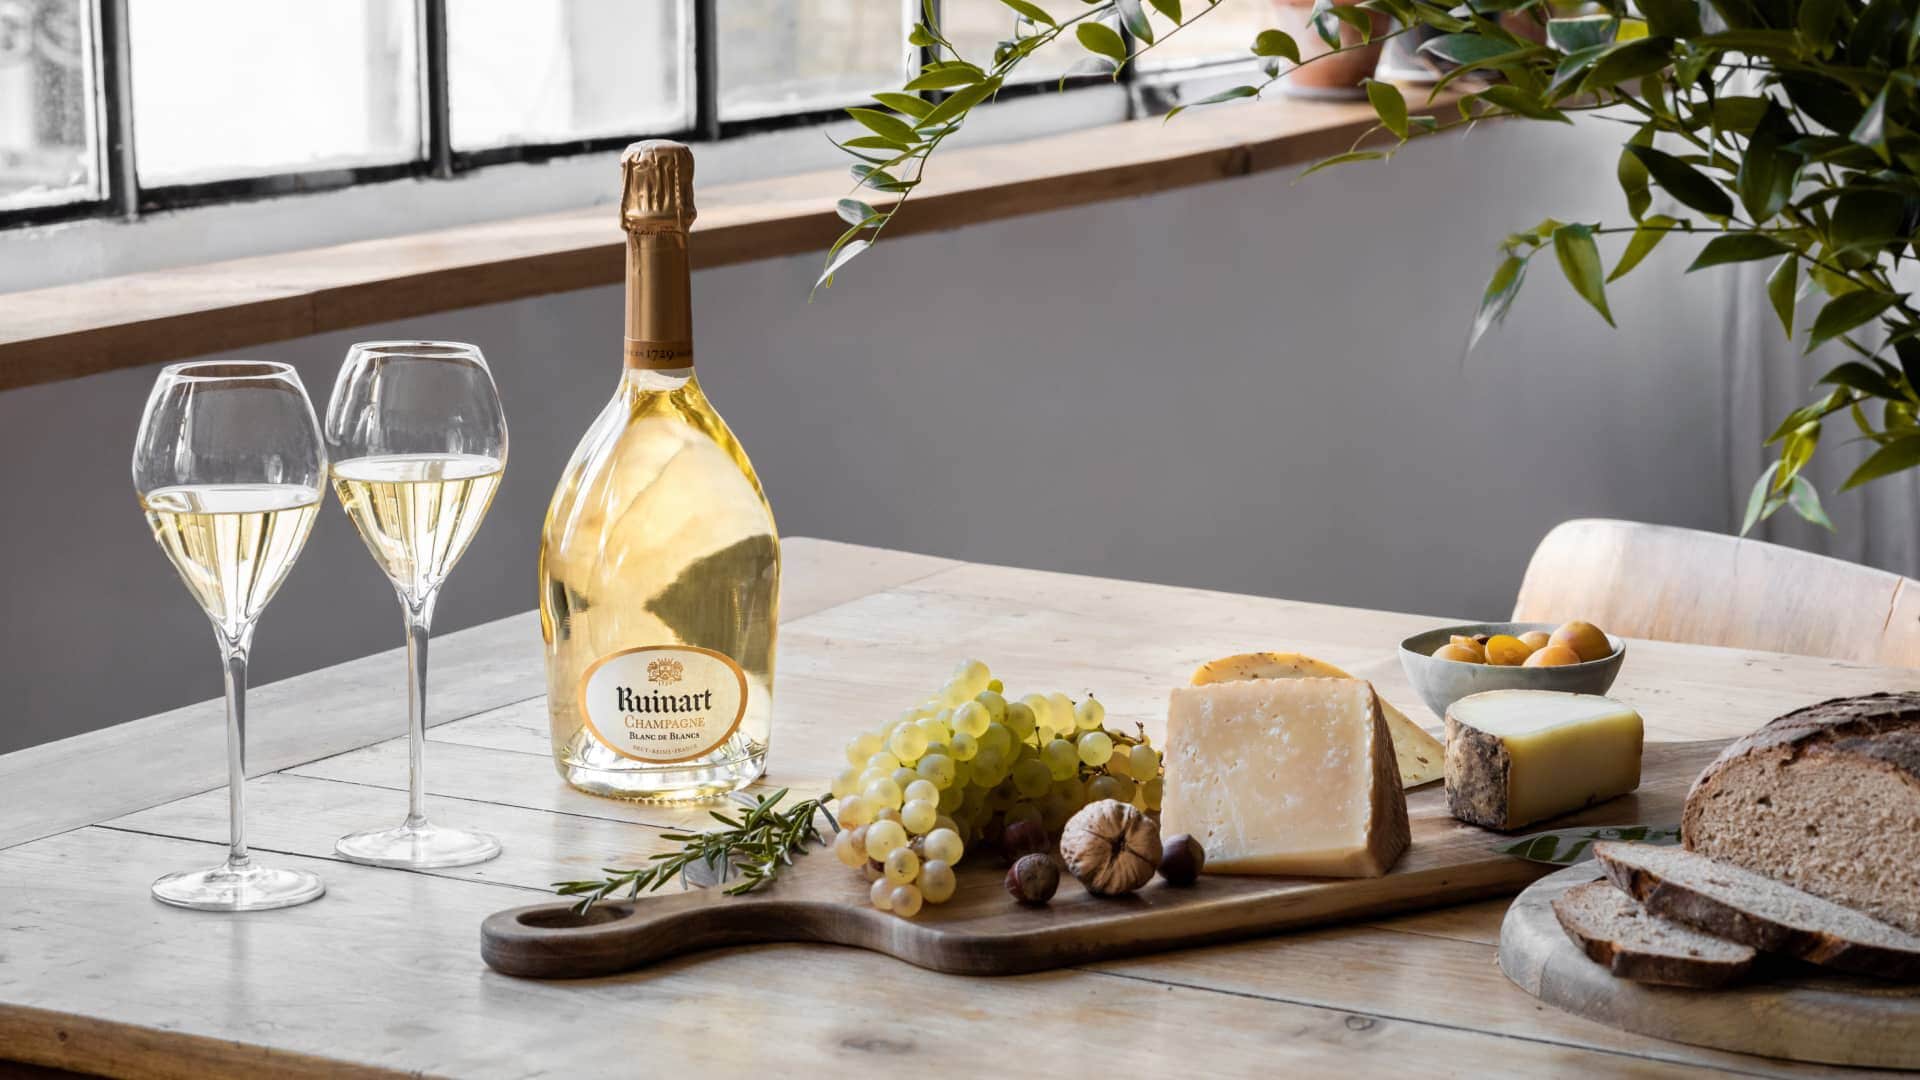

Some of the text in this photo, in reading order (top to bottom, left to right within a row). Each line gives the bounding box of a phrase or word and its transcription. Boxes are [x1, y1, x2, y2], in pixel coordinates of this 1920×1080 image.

[616, 686, 712, 713] Ruinart
[624, 714, 705, 729] CHAMPAGNE
[629, 731, 656, 741] BLANC
[669, 731, 700, 741] BLANCS
